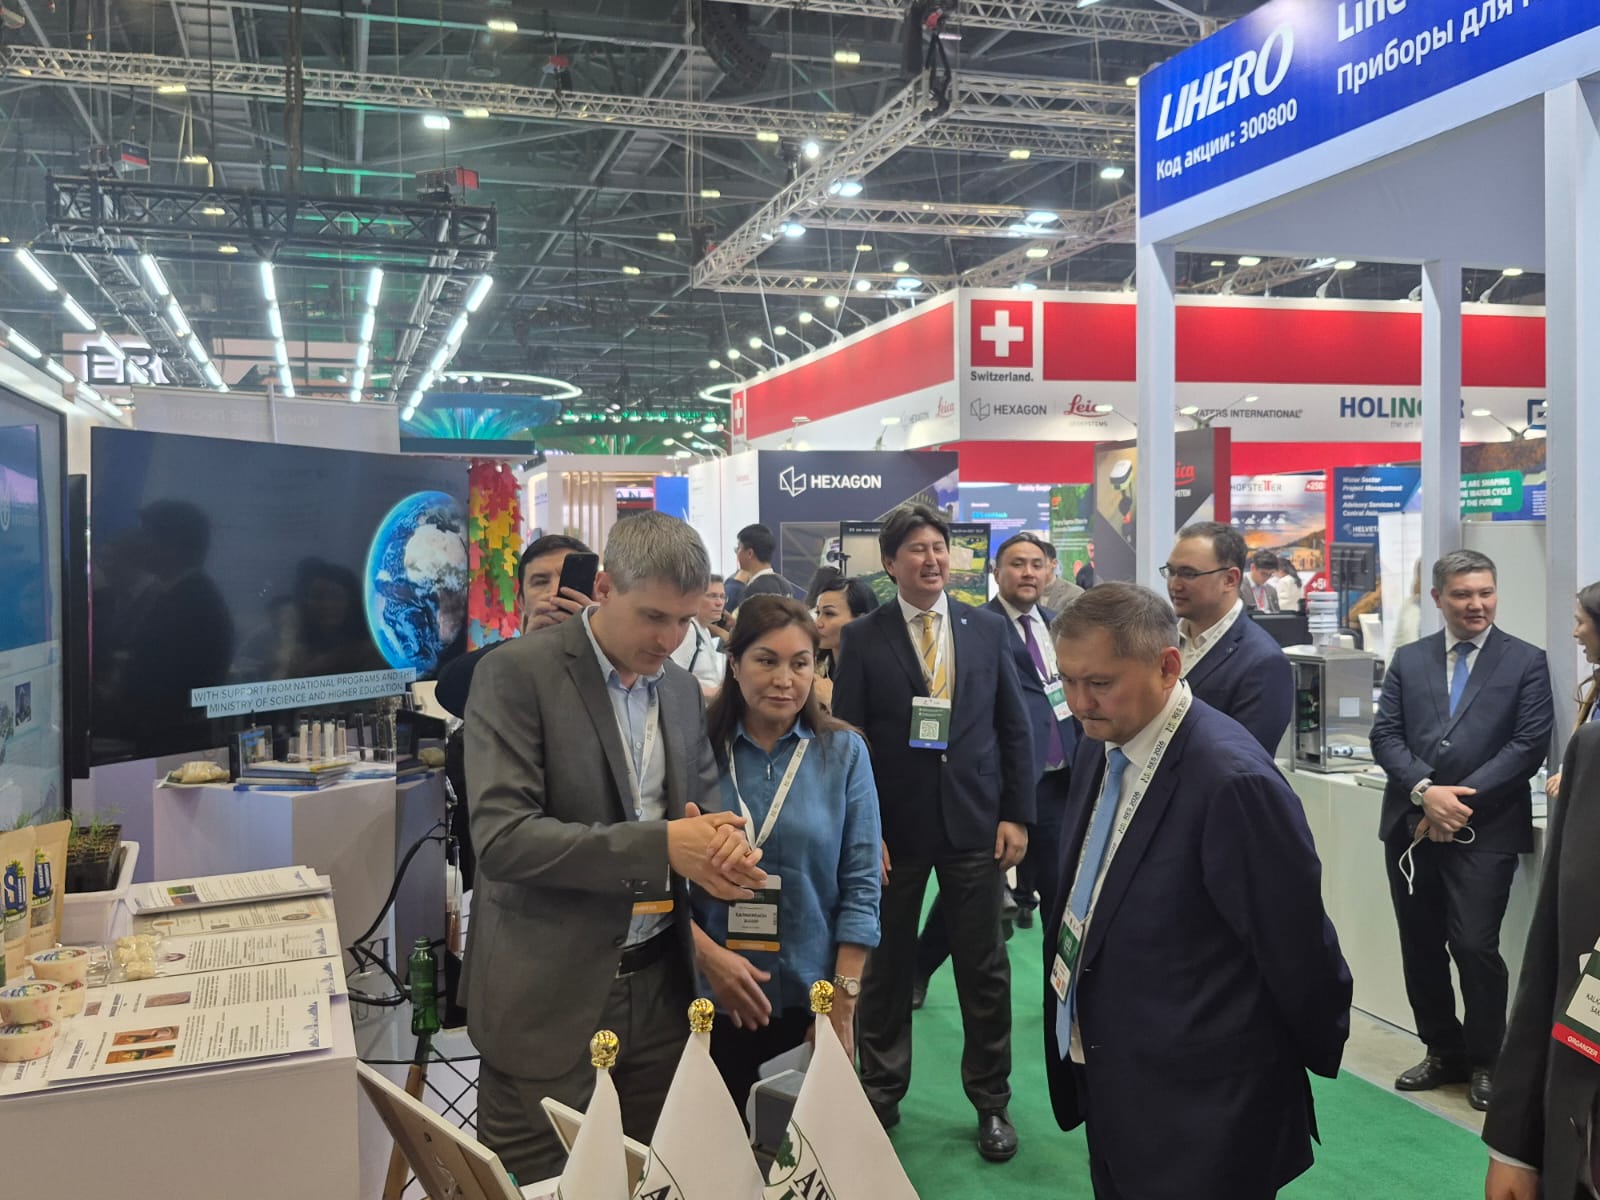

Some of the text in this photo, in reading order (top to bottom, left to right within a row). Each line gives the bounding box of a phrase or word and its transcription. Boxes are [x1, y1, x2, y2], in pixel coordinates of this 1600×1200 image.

[1337, 0, 1513, 95] Приборы для
[1156, 22, 1294, 141] LIHERO
[1156, 98, 1298, 181] Код акции: 300800
[970, 371, 1034, 382] Switzerland.
[993, 404, 1047, 416] HEXAGON
[1063, 394, 1112, 418] Leic
[810, 475, 882, 489] HEXAGON
[193, 690, 219, 703] WITH
[222, 686, 264, 700] SUPPORT
[266, 683, 292, 695] FROM
[293, 678, 336, 693] NATIONAL
[337, 675, 380, 688] PROGRAMS
[380, 672, 399, 683] AND
[209, 682, 404, 714] MINISTRY OF SCIENCE AND HIGHER EDUCATION
